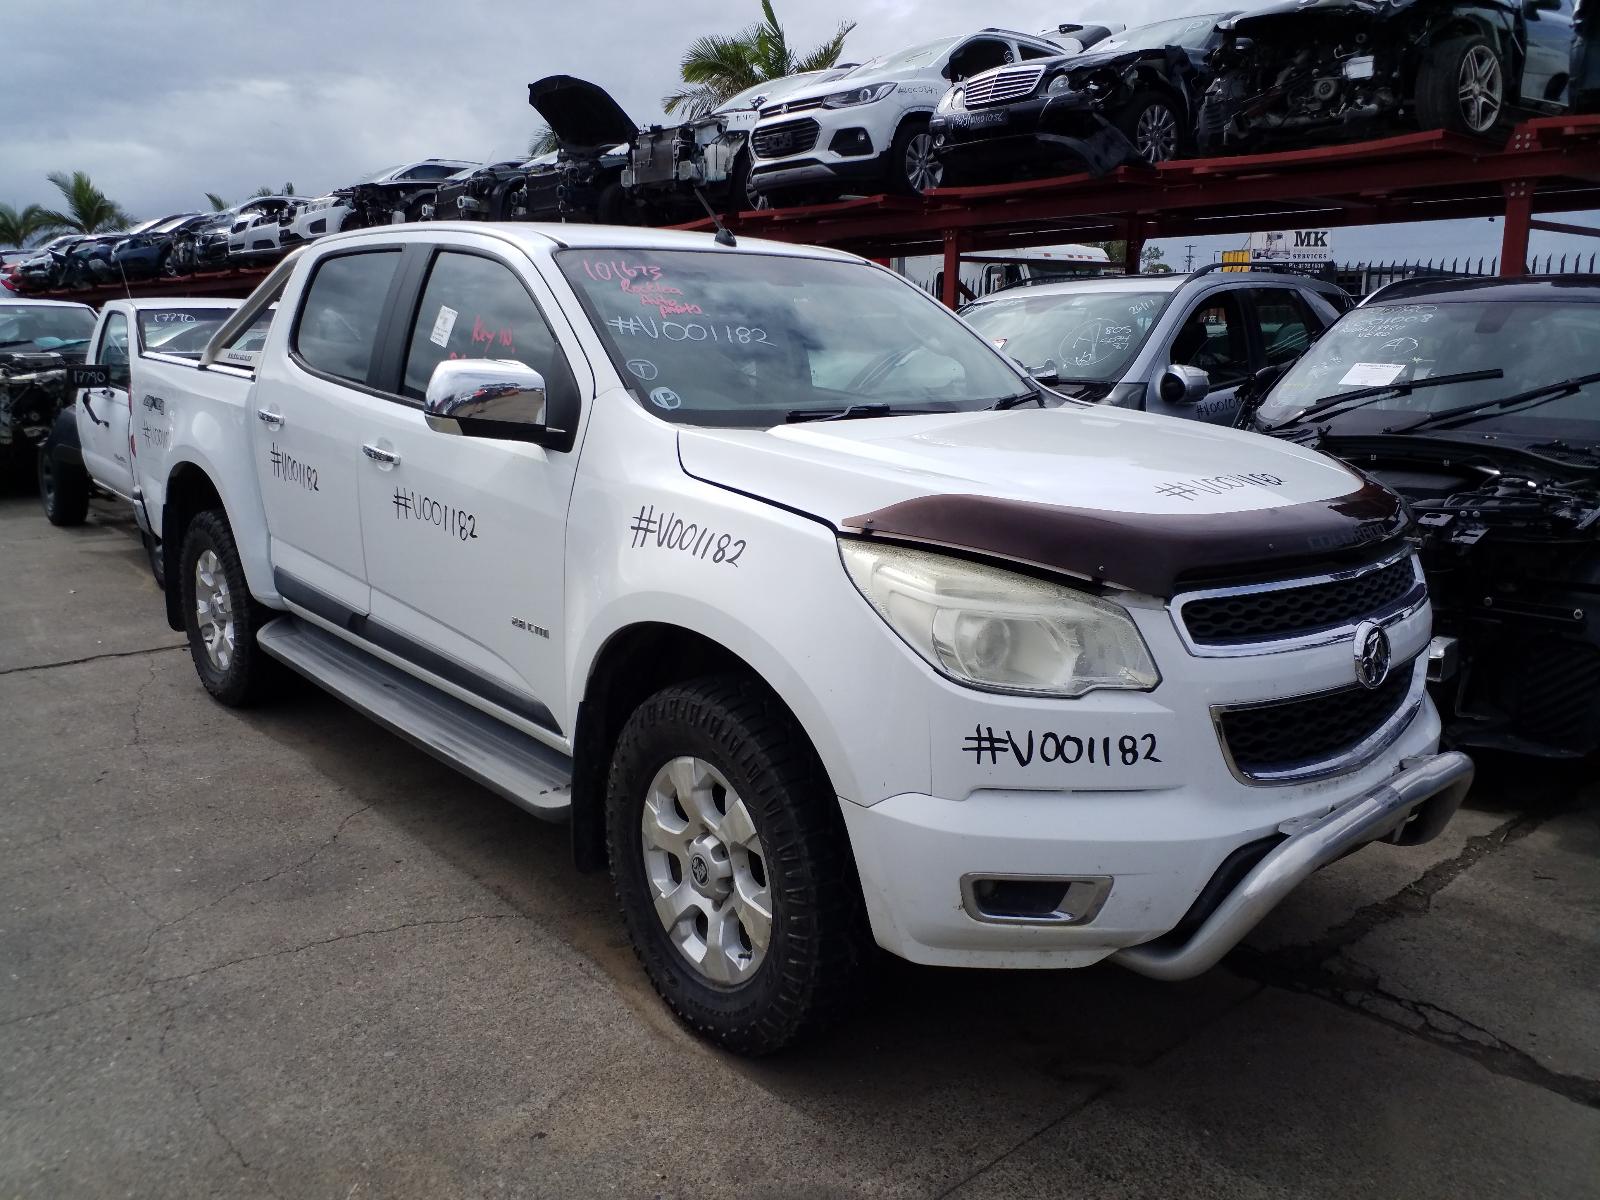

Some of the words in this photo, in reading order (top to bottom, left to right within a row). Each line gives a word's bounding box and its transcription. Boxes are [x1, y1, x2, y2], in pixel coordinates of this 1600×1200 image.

[1294, 231, 1329, 248] MK
[605, 315, 778, 348] #V001182
[270, 442, 320, 491] #V001182
[392, 486, 479, 541] #V001182
[630, 504, 748, 568] #V001182
[962, 723, 1164, 768] #V001182
